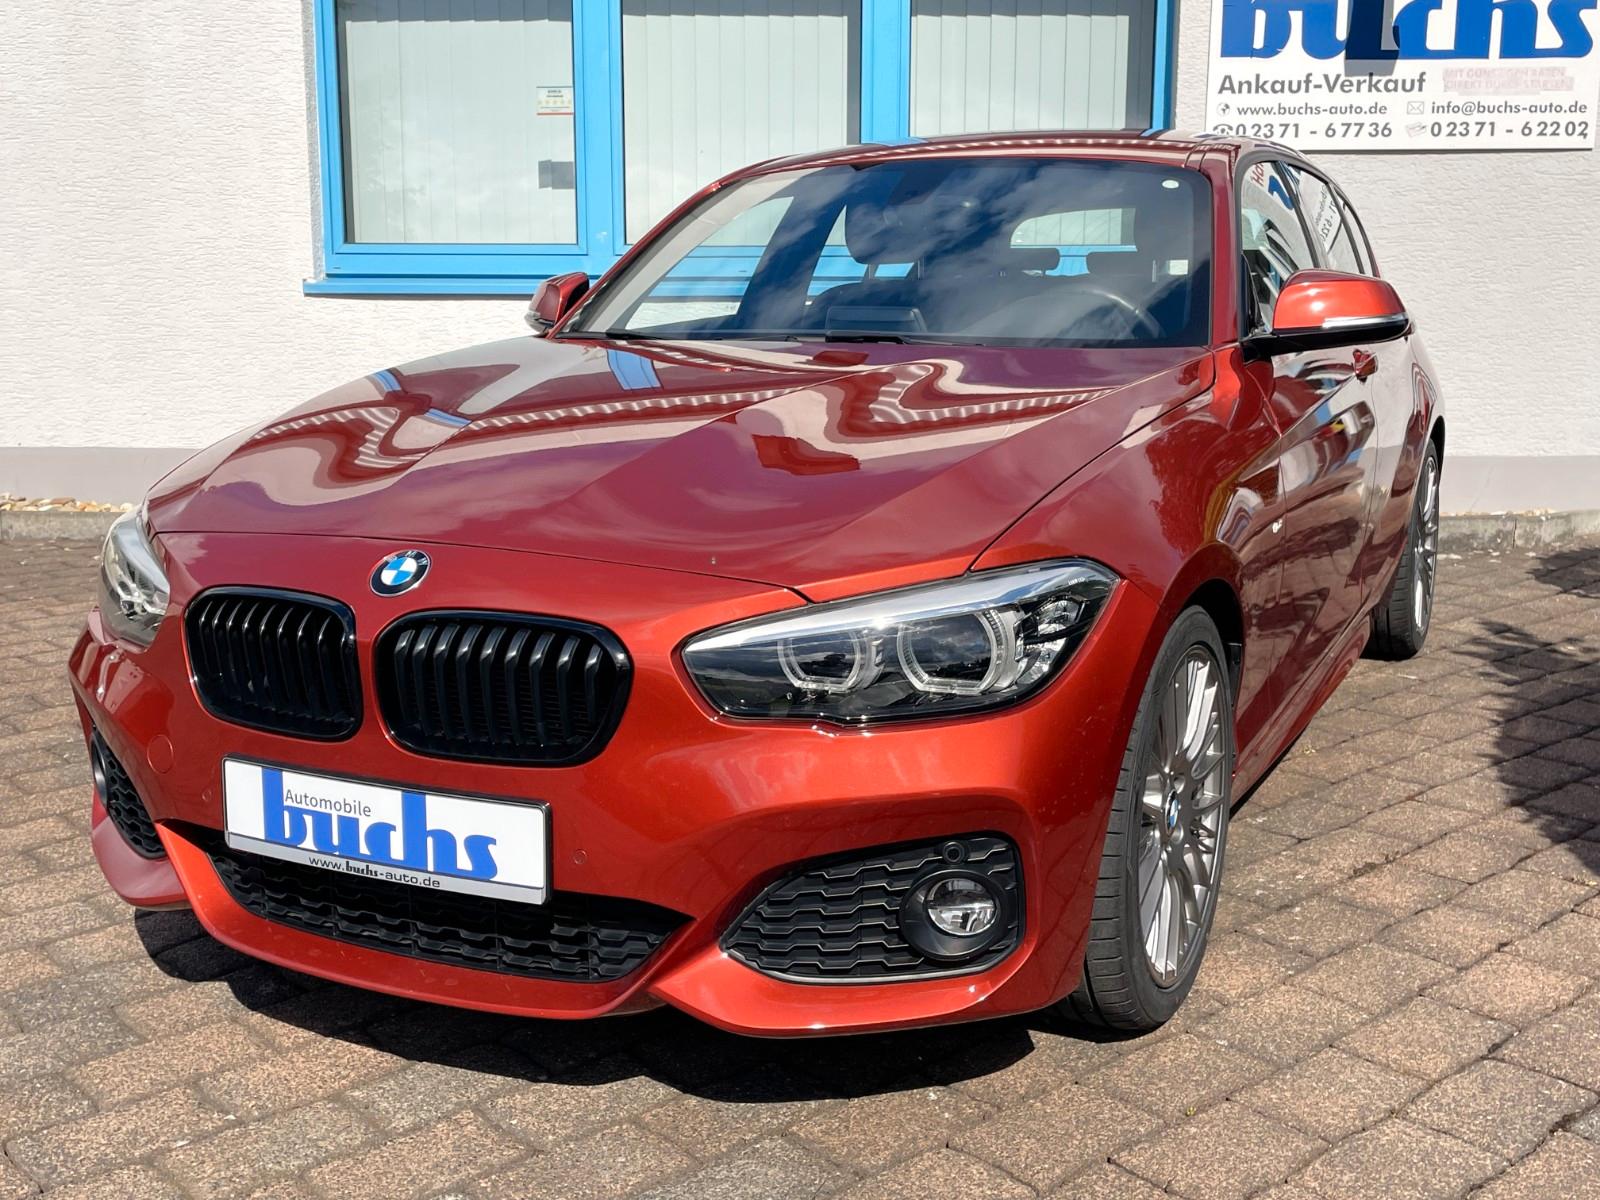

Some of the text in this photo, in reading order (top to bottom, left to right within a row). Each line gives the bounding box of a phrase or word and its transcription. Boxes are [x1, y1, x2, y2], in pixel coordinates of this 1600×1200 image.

[1218, 72, 1426, 96] Ankauf-Verkauf
[1237, 102, 1388, 115] www.buchs-auto.de
[1431, 101, 1588, 116] info@buchs-auto.de
[285, 788, 372, 817] Automobile
[262, 767, 498, 880] buchs
[308, 856, 441, 888] www.buchs-auto.de
